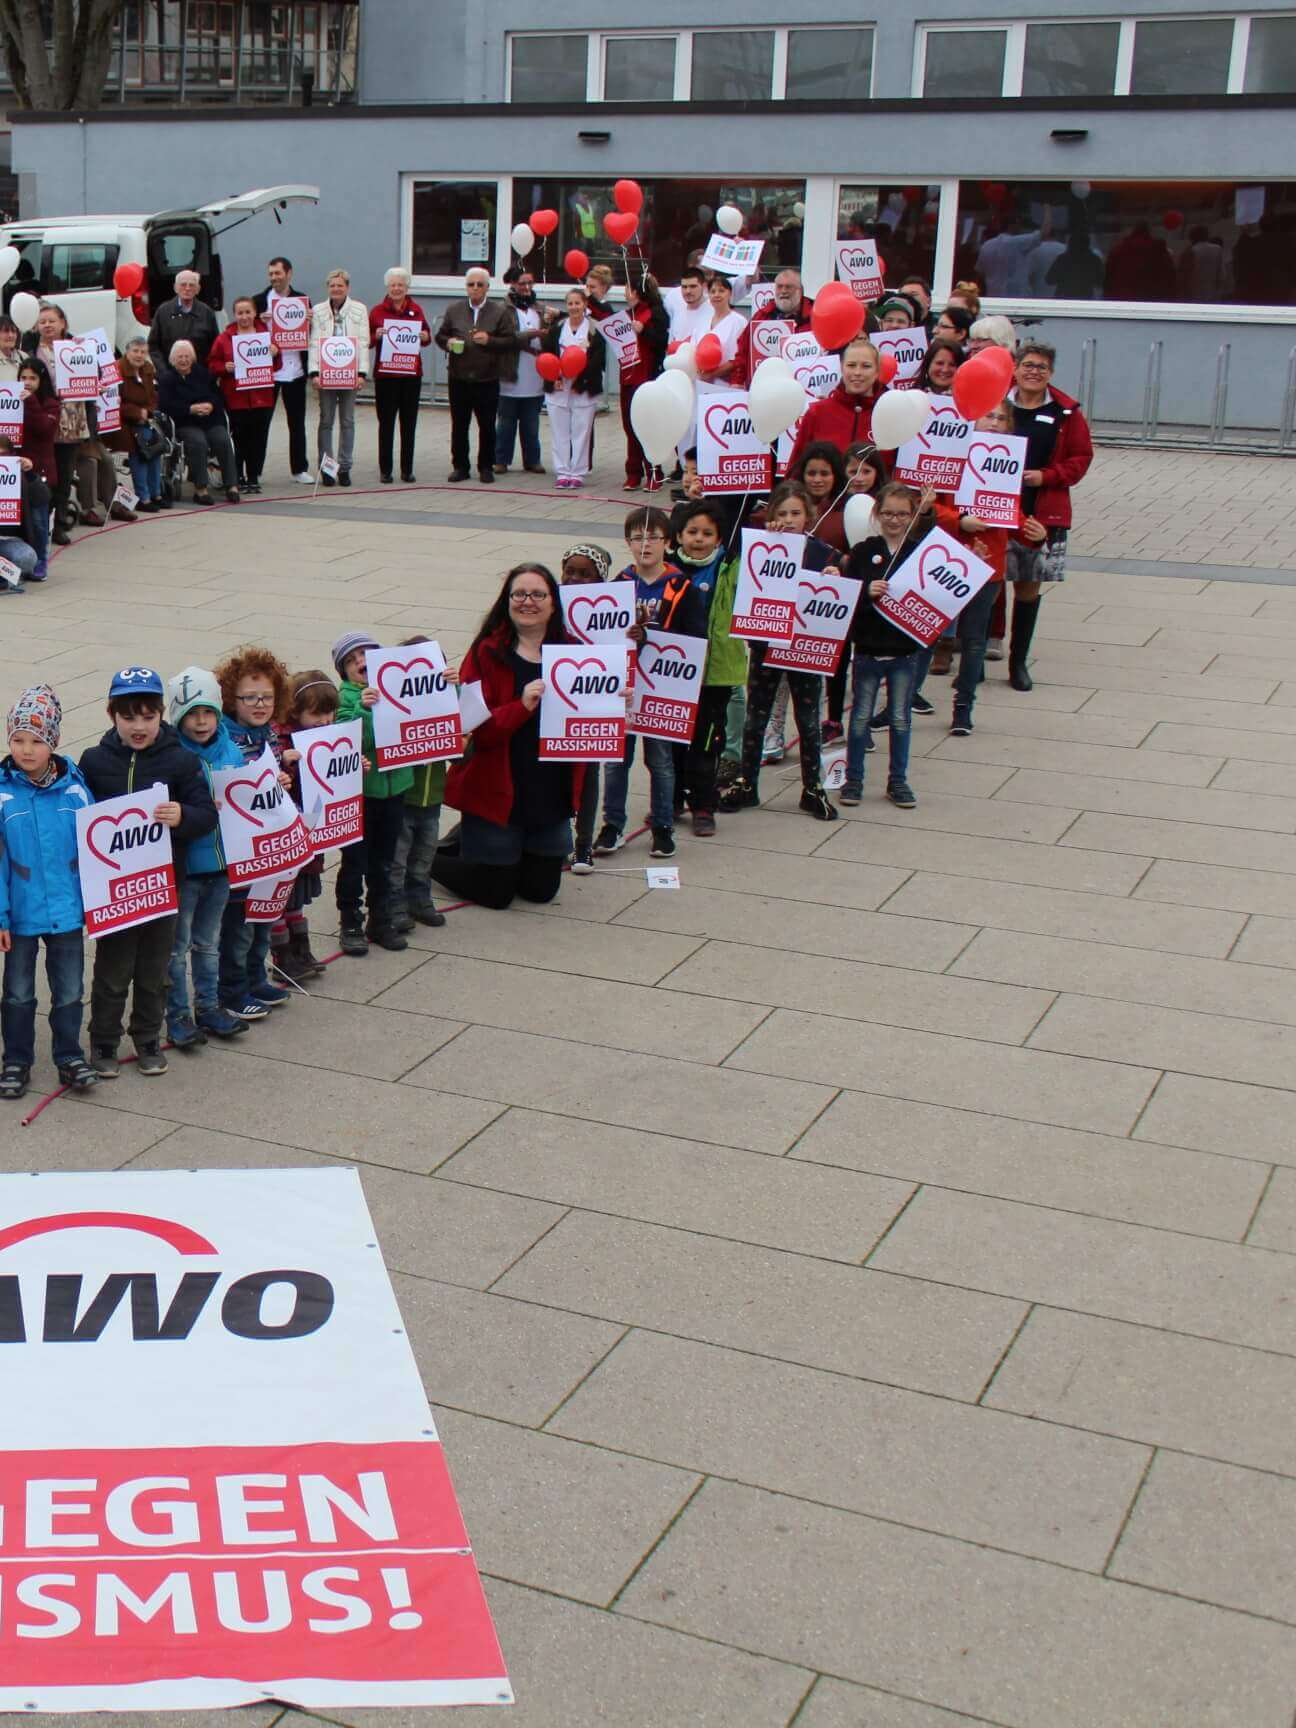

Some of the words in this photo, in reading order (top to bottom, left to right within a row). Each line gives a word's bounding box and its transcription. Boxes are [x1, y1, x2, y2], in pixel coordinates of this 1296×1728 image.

[850, 256, 874, 268] AWO
[854, 280, 880, 290] GEGEN
[284, 310, 304, 320] AWO
[275, 332, 307, 340] GEGEN
[614, 322, 632, 337] AWO
[396, 334, 418, 344] AWO
[766, 336, 779, 344] AW
[70, 355, 94, 365] AWO
[246, 346, 268, 358] AWO
[332, 348, 353, 357] AWO
[394, 354, 416, 363] GEGEN
[795, 346, 818, 358] AWO
[247, 368, 271, 377] GEGEN
[324, 370, 354, 379] GEGEN
[808, 372, 838, 388] AWO
[721, 418, 756, 435] AW
[926, 420, 968, 439] AWO
[724, 458, 764, 472] GEGEN
[920, 458, 962, 474] GEGEN
[981, 457, 1020, 475] AWO
[704, 473, 766, 486] RASSISMUS!
[900, 468, 958, 486] RASSISMUS!
[977, 494, 1015, 509] GEGEN
[759, 559, 796, 579] AWO
[928, 566, 970, 598] AWO
[754, 602, 791, 619] GEGEN
[804, 600, 848, 620] AWO
[880, 594, 934, 638] RASSISMUS!
[904, 596, 944, 628] GEGEN
[586, 610, 630, 632] AWO
[736, 617, 788, 633] RASSISMUS!
[794, 639, 838, 654] GEGEN
[771, 648, 834, 667] RASSISMUS!
[649, 658, 696, 680] AWO
[400, 672, 445, 698] AWO
[570, 676, 620, 694] AWO
[645, 701, 691, 720] GEGEN
[405, 720, 455, 742] GEGEN
[570, 722, 619, 736] GEGEN
[384, 737, 458, 760] RASSISMUS!
[546, 740, 618, 752] RASSISMUS!
[326, 752, 360, 779] AWO
[329, 801, 360, 824] GEGEN
[109, 822, 164, 854] AWO
[258, 822, 304, 855] GEGEN
[311, 819, 360, 844] RASSISMUS!
[236, 840, 309, 876] RASSISMUS!
[115, 871, 168, 900] GEGEN
[93, 890, 170, 925] RASSISMUS!
